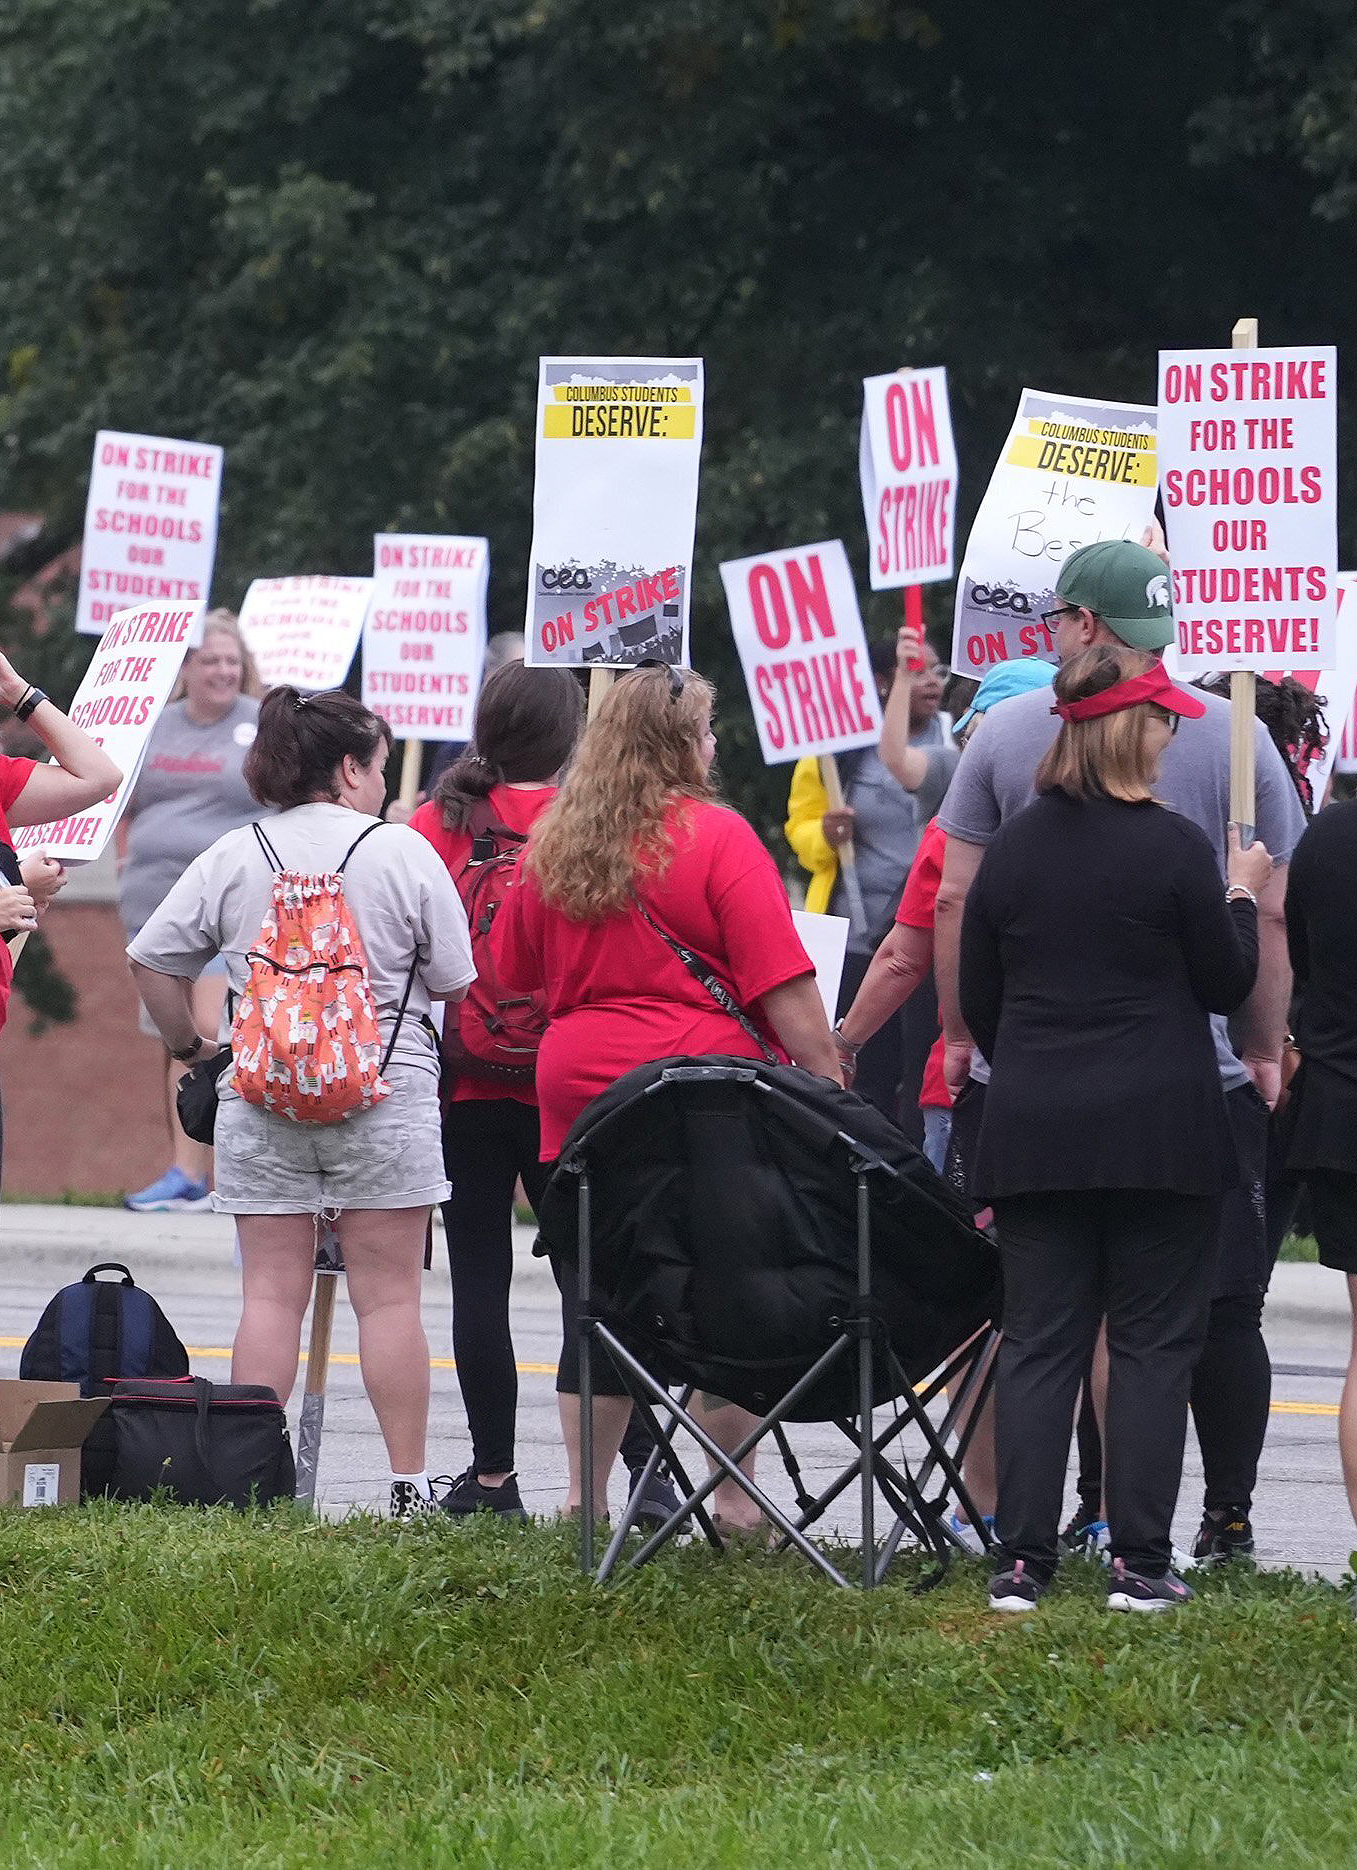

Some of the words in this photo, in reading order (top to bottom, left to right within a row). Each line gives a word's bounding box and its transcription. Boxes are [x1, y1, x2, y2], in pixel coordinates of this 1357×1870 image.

[566, 385, 619, 402] COLUMBUS
[621, 386, 678, 403] STUDENTS
[1165, 364, 1202, 404] ON
[1210, 360, 1326, 402] STRIKE
[571, 405, 668, 438] DESERVE:
[885, 379, 940, 472] ON
[1040, 421, 1100, 445] COLUMBUS
[1100, 429, 1149, 451] STUDENTS
[1190, 419, 1236, 452] FOR
[1244, 417, 1294, 450] THE
[101, 442, 130, 467] ON
[134, 446, 215, 479] STRIKE
[1037, 440, 1141, 484] DESERVE:
[117, 480, 150, 501] FOR
[157, 484, 188, 508] THE
[1042, 480, 1097, 516] the
[1166, 465, 1322, 507] SCHOOLS
[94, 507, 203, 544] SCHOOLS
[878, 479, 951, 575] STRIKE
[1212, 519, 1268, 552] OUR
[127, 544, 165, 566] OUR
[380, 545, 404, 568] ON
[409, 545, 478, 570] STRIKE
[87, 568, 201, 601] STUDENTS
[394, 580, 420, 599] FOR
[426, 579, 452, 600] THE
[747, 554, 836, 650] ON
[1172, 566, 1327, 605] STUDENTS
[372, 609, 469, 635] SCHOOLS
[541, 611, 575, 653] ON
[583, 566, 680, 633] STRIKE
[99, 620, 125, 653] ON
[122, 611, 194, 646] STRIKE
[966, 630, 1008, 666] ON
[1178, 617, 1320, 655] DESERVE!
[400, 642, 435, 661] OUR
[93, 659, 120, 689] FOR
[120, 656, 157, 683] THE
[368, 671, 470, 696] STUDENTS
[71, 695, 155, 730] SCHOOLS
[754, 648, 875, 751] STRIKE
[14, 817, 103, 850] DESERVE!
